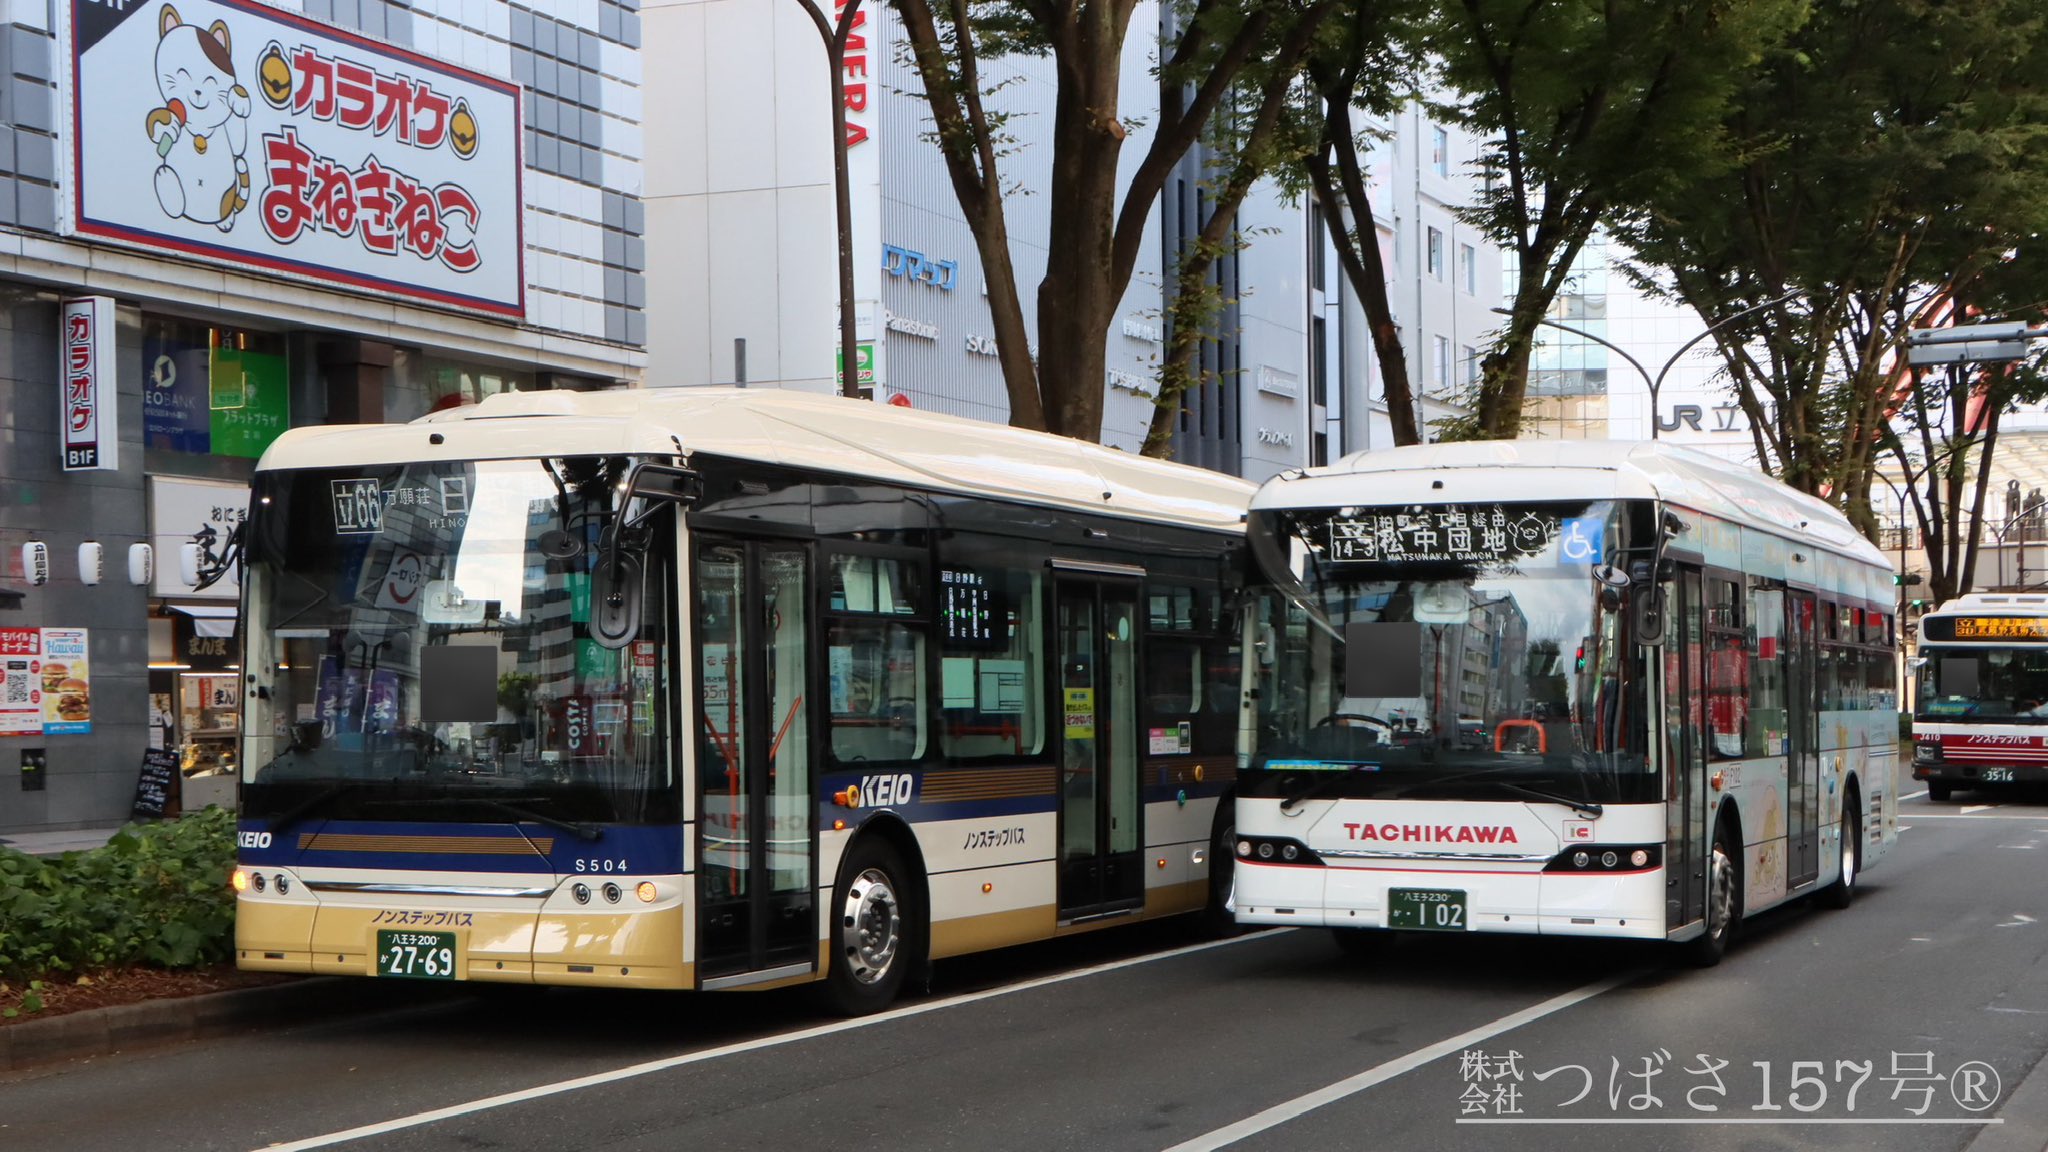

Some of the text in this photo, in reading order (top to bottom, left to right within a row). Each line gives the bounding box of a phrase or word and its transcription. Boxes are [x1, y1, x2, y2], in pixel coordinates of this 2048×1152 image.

[292, 49, 450, 146] カラオケ
[261, 128, 480, 270] まねきねこ
[69, 316, 92, 432] カラオケ
[69, 450, 95, 465] B1F
[335, 483, 381, 529] 立66
[382, 487, 431, 506] 万願荘
[429, 517, 466, 528] HINO
[1, 632, 29, 642] モバイル
[188, 636, 226, 655] まんま
[858, 774, 912, 807] KEIO
[238, 832, 272, 849] KEIO
[963, 827, 1026, 851] ノンステップバス
[1343, 822, 1519, 844] TACHIKAWA
[575, 858, 628, 872] S504
[371, 910, 474, 927] ノンステップバス
[390, 945, 453, 976] 27-69
